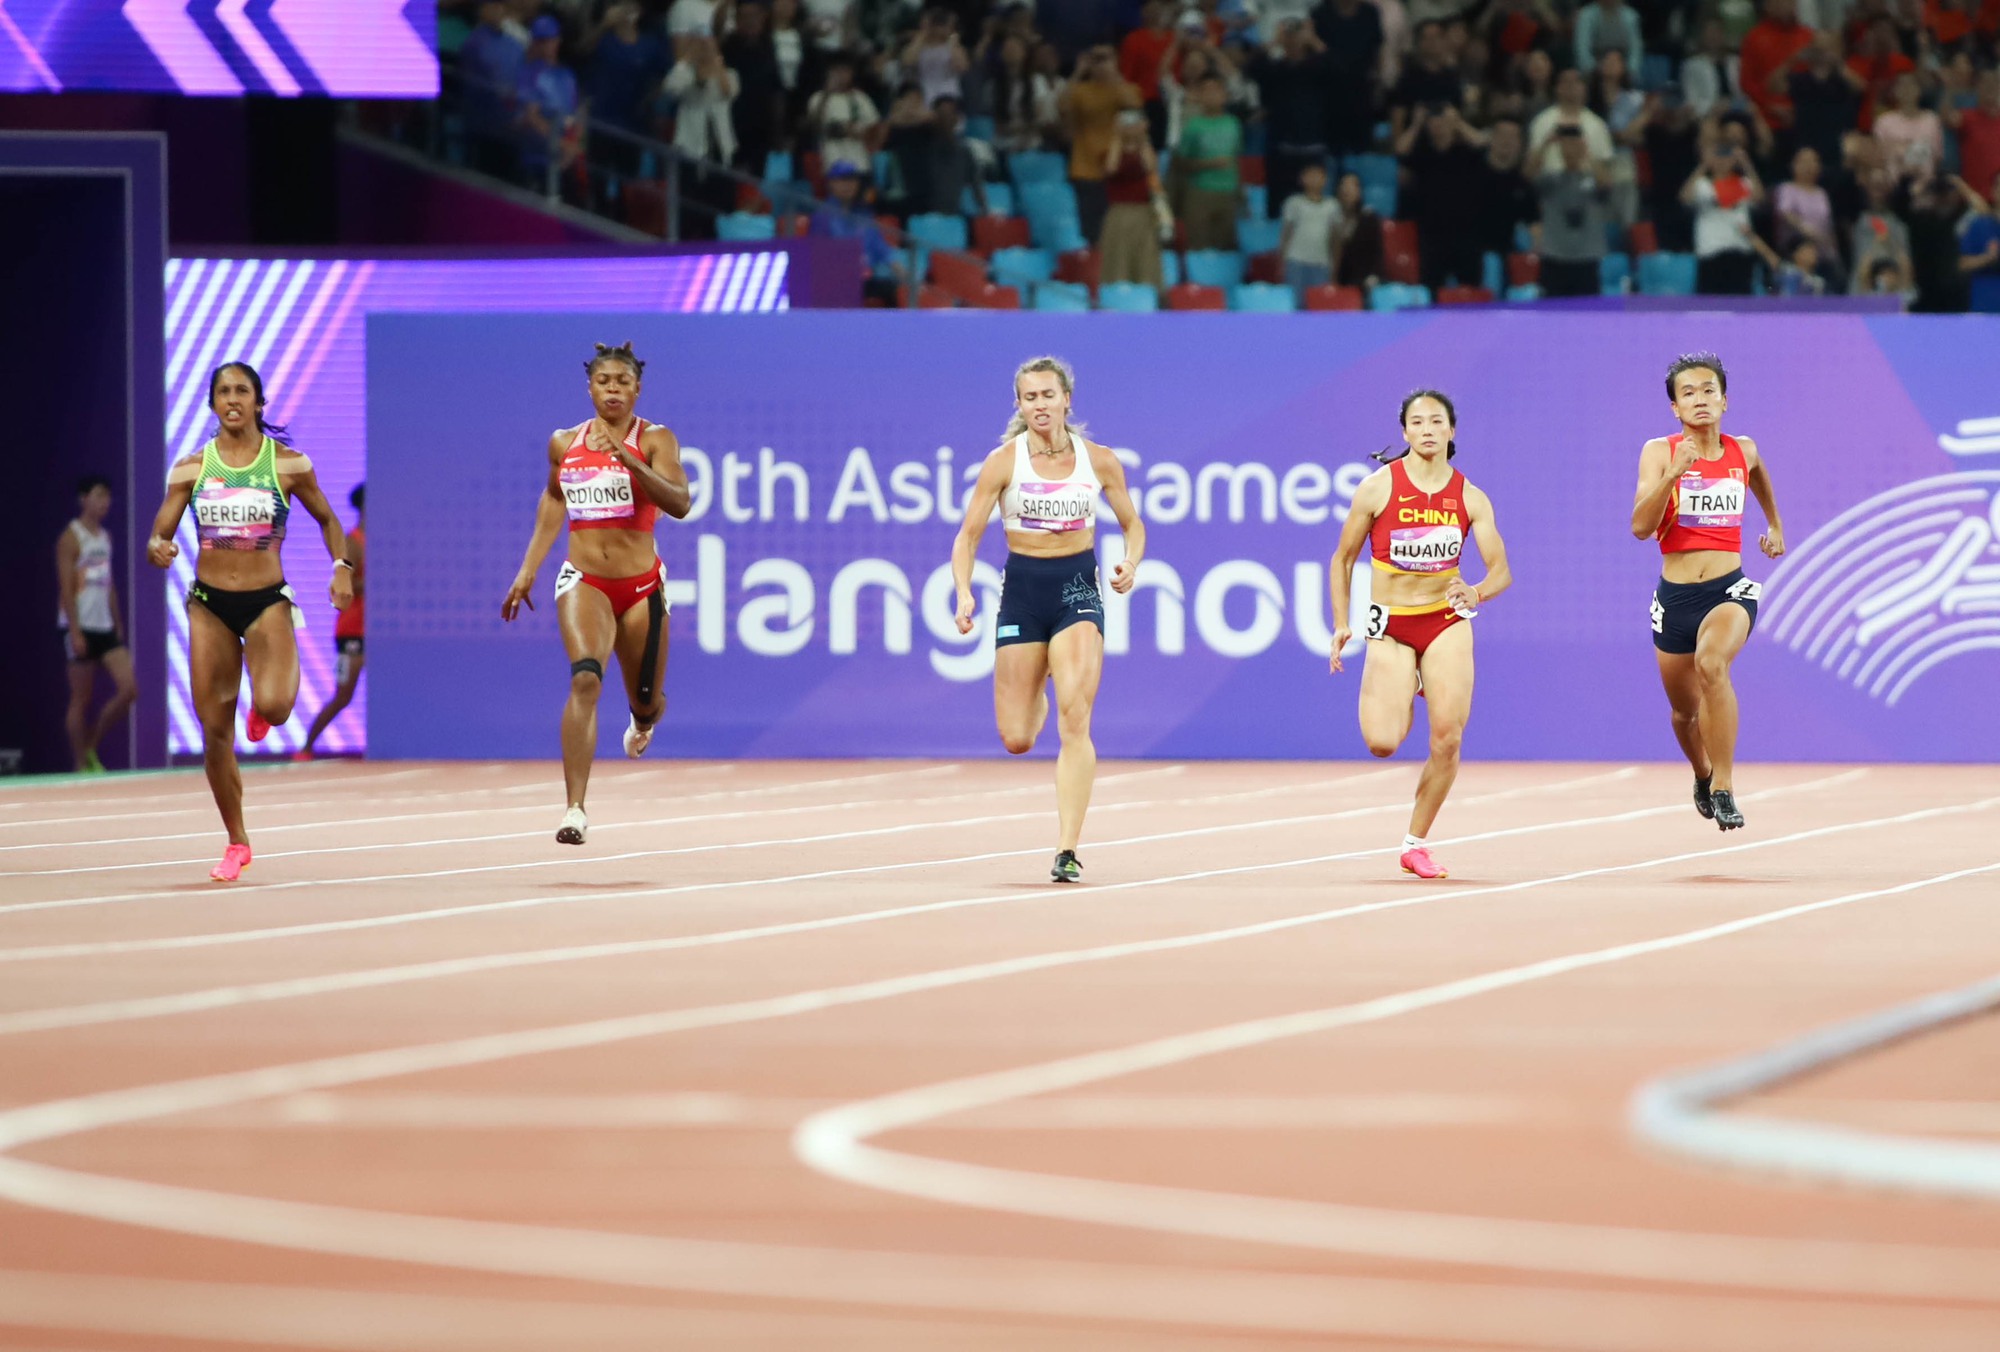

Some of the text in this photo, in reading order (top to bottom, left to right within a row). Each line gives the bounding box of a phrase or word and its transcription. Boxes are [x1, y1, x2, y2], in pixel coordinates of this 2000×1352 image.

[566, 486, 629, 504] ODIONG
[1689, 495, 1737, 511] TRAN
[200, 505, 269, 522] PEREIRA
[1023, 500, 1089, 517] SAFRONOVA
[1398, 507, 1460, 526] CHINA
[1394, 541, 1459, 558] HUANG
[664, 532, 1372, 681] Hanghou
[1367, 604, 1383, 637] 3
